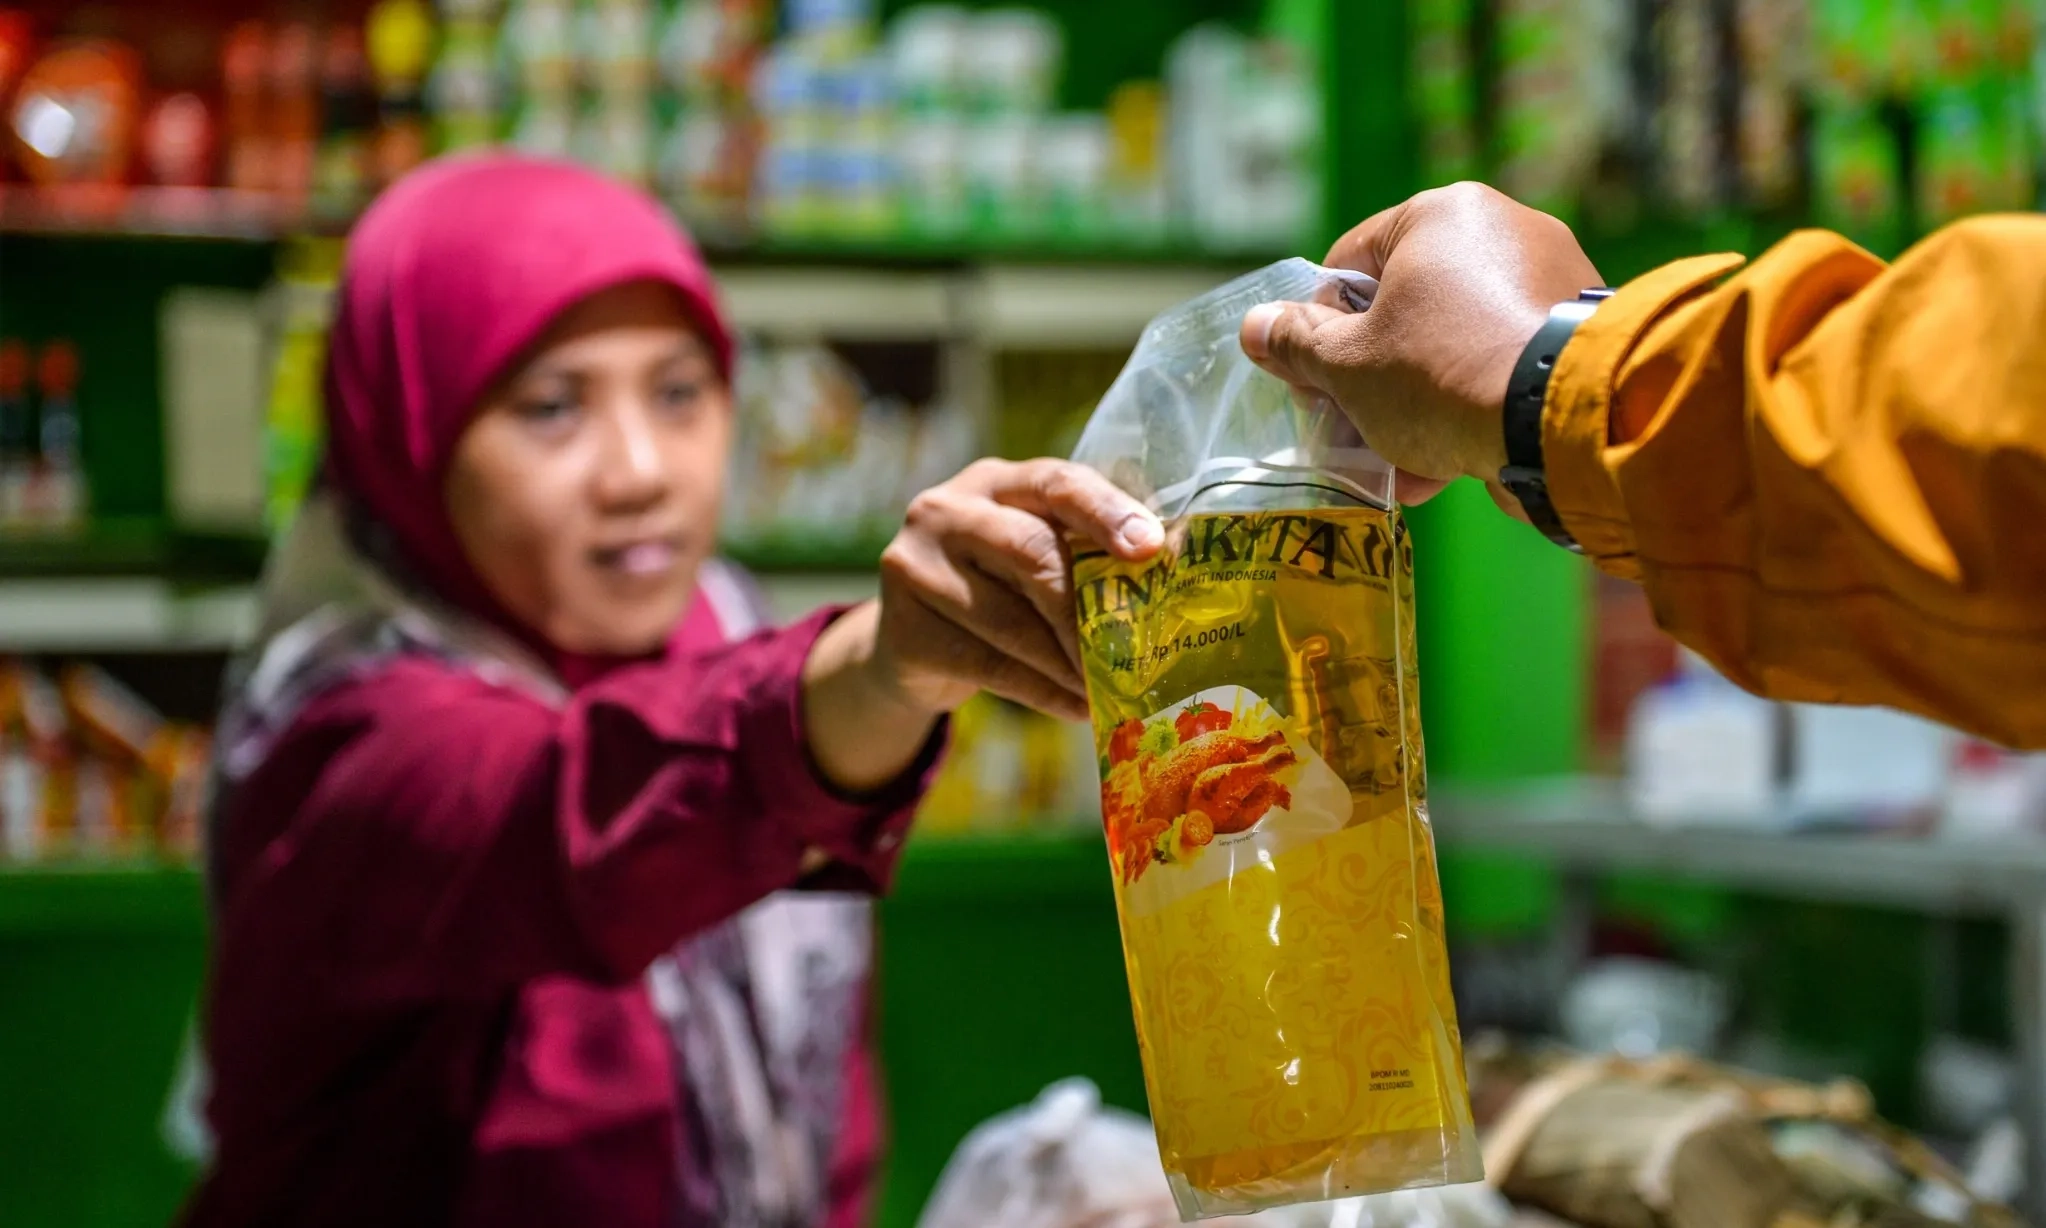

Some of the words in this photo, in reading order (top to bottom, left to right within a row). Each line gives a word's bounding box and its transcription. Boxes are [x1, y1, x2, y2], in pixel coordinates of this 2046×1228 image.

[1175, 571, 1208, 593] SAWIT
[1210, 569, 1277, 582] INDONESIA
[1150, 644, 1169, 662] Rp
[1173, 621, 1245, 653] 14.000/L
